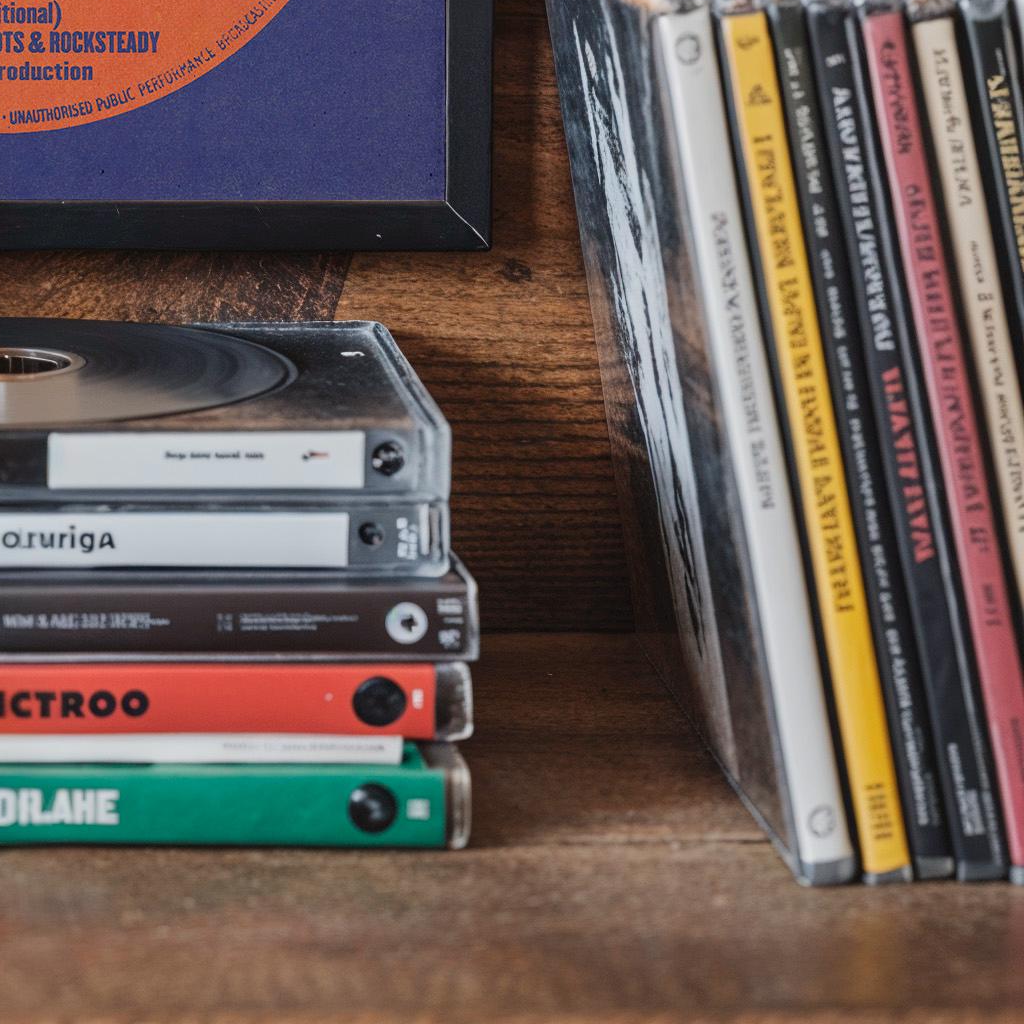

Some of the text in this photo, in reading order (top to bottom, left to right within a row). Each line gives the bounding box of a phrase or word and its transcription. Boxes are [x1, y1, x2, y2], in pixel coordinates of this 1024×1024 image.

[28, 31, 45, 53] &
[50, 31, 160, 53] ROCKSTEADY
[10, 101, 93, 125] UNAUTHORISED
[96, 87, 135, 111] PUBLIC
